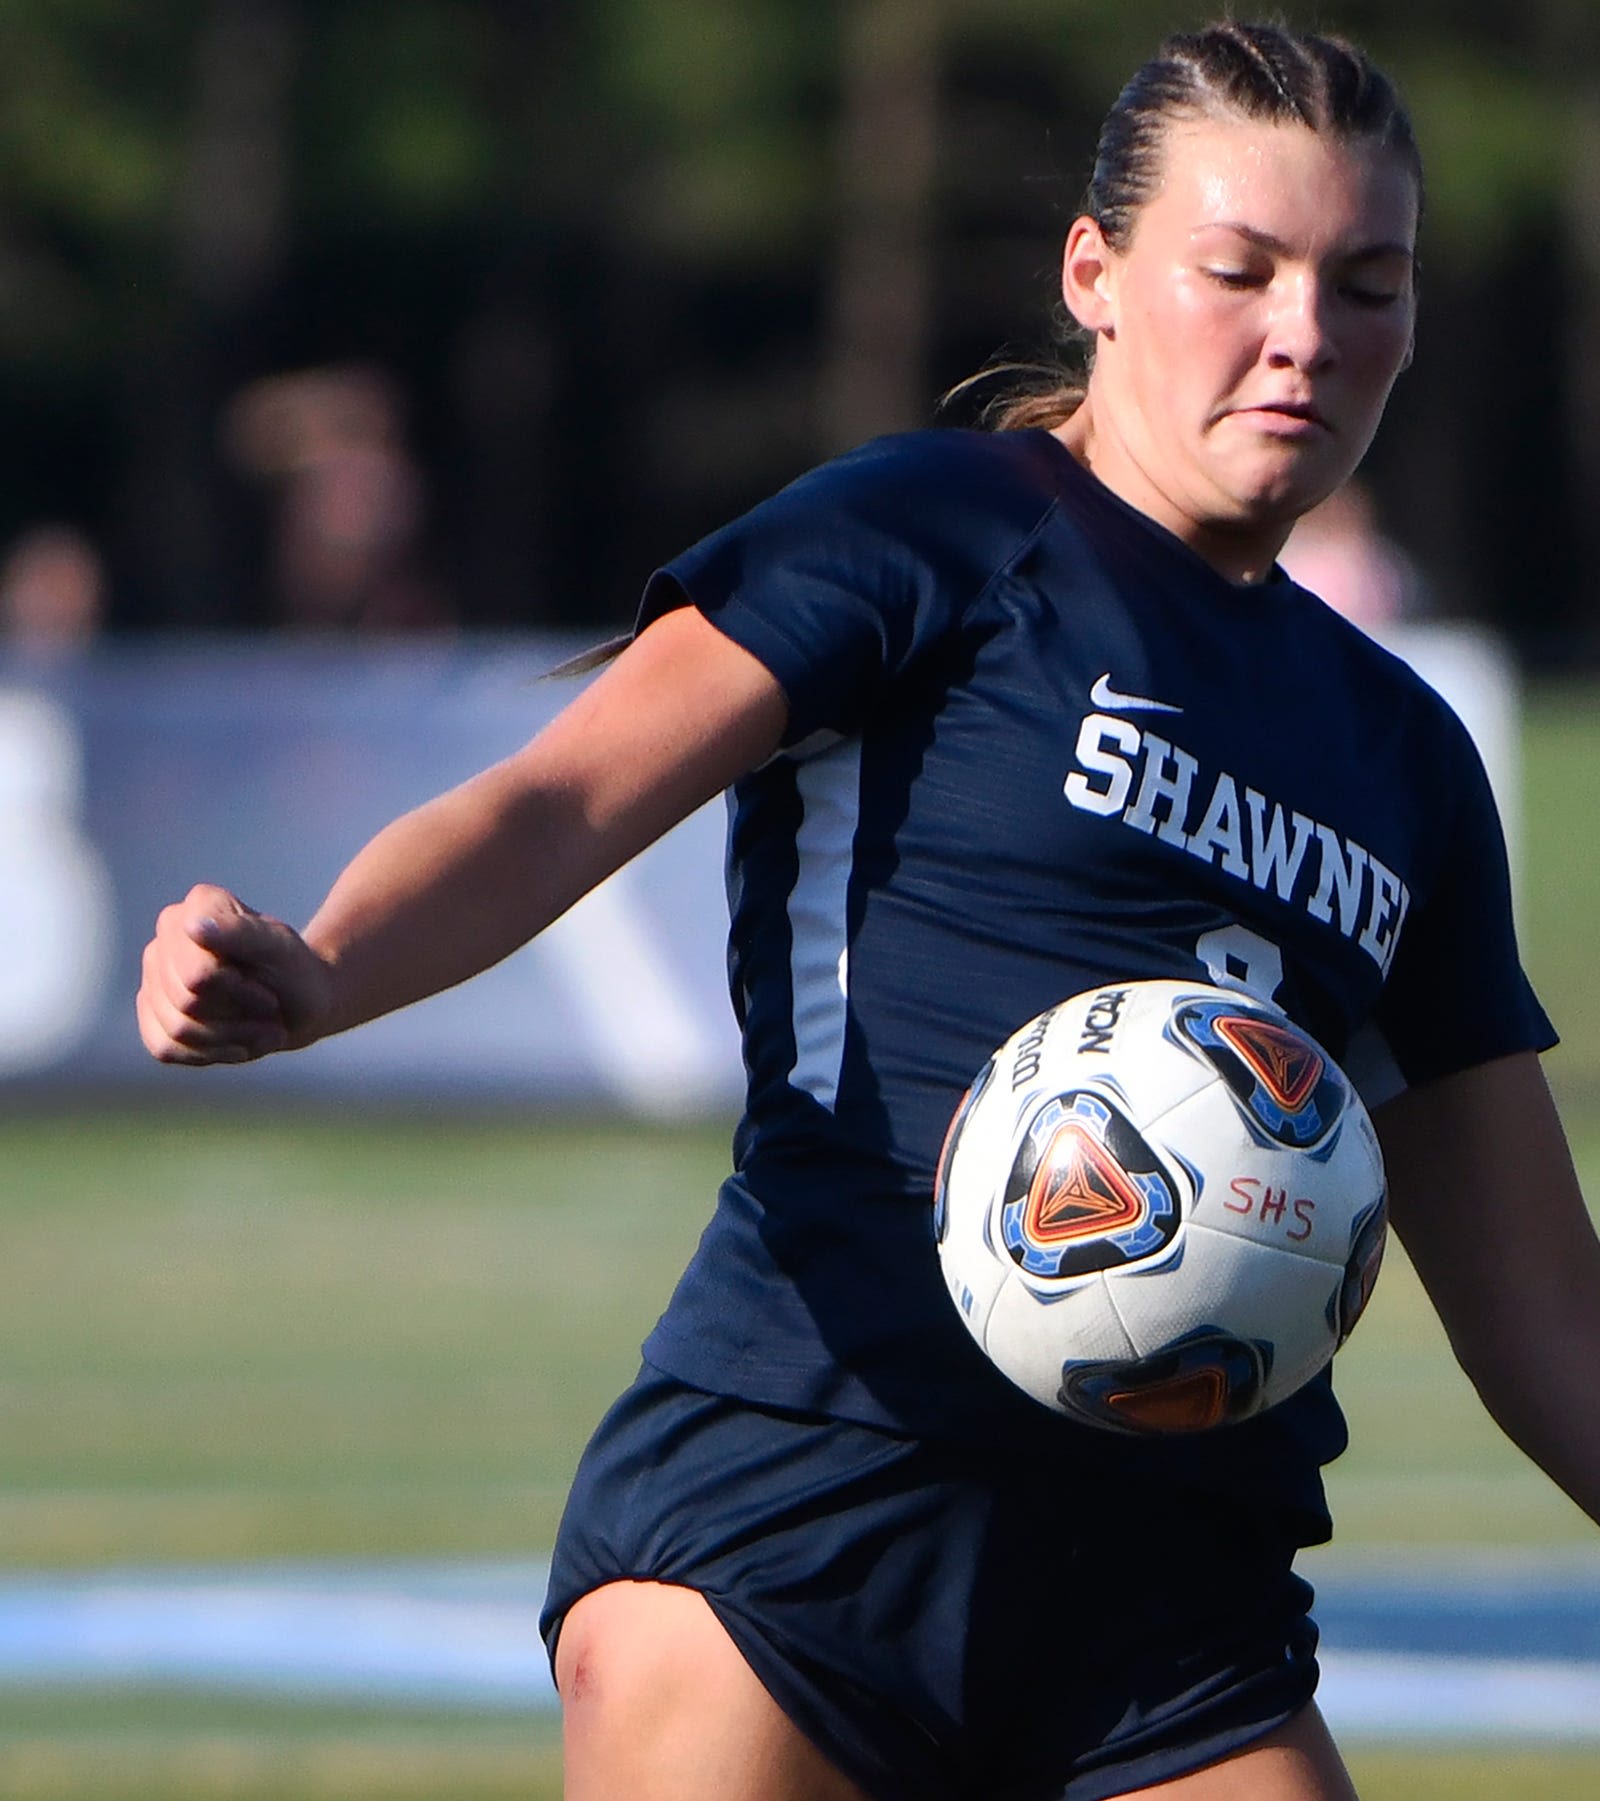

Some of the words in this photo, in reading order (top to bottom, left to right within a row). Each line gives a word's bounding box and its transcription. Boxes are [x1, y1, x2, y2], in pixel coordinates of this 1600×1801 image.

[1063, 712, 1411, 983] SHAWNE
[1077, 988, 1132, 1054] NCAA
[1223, 1177, 1316, 1242] SHS
